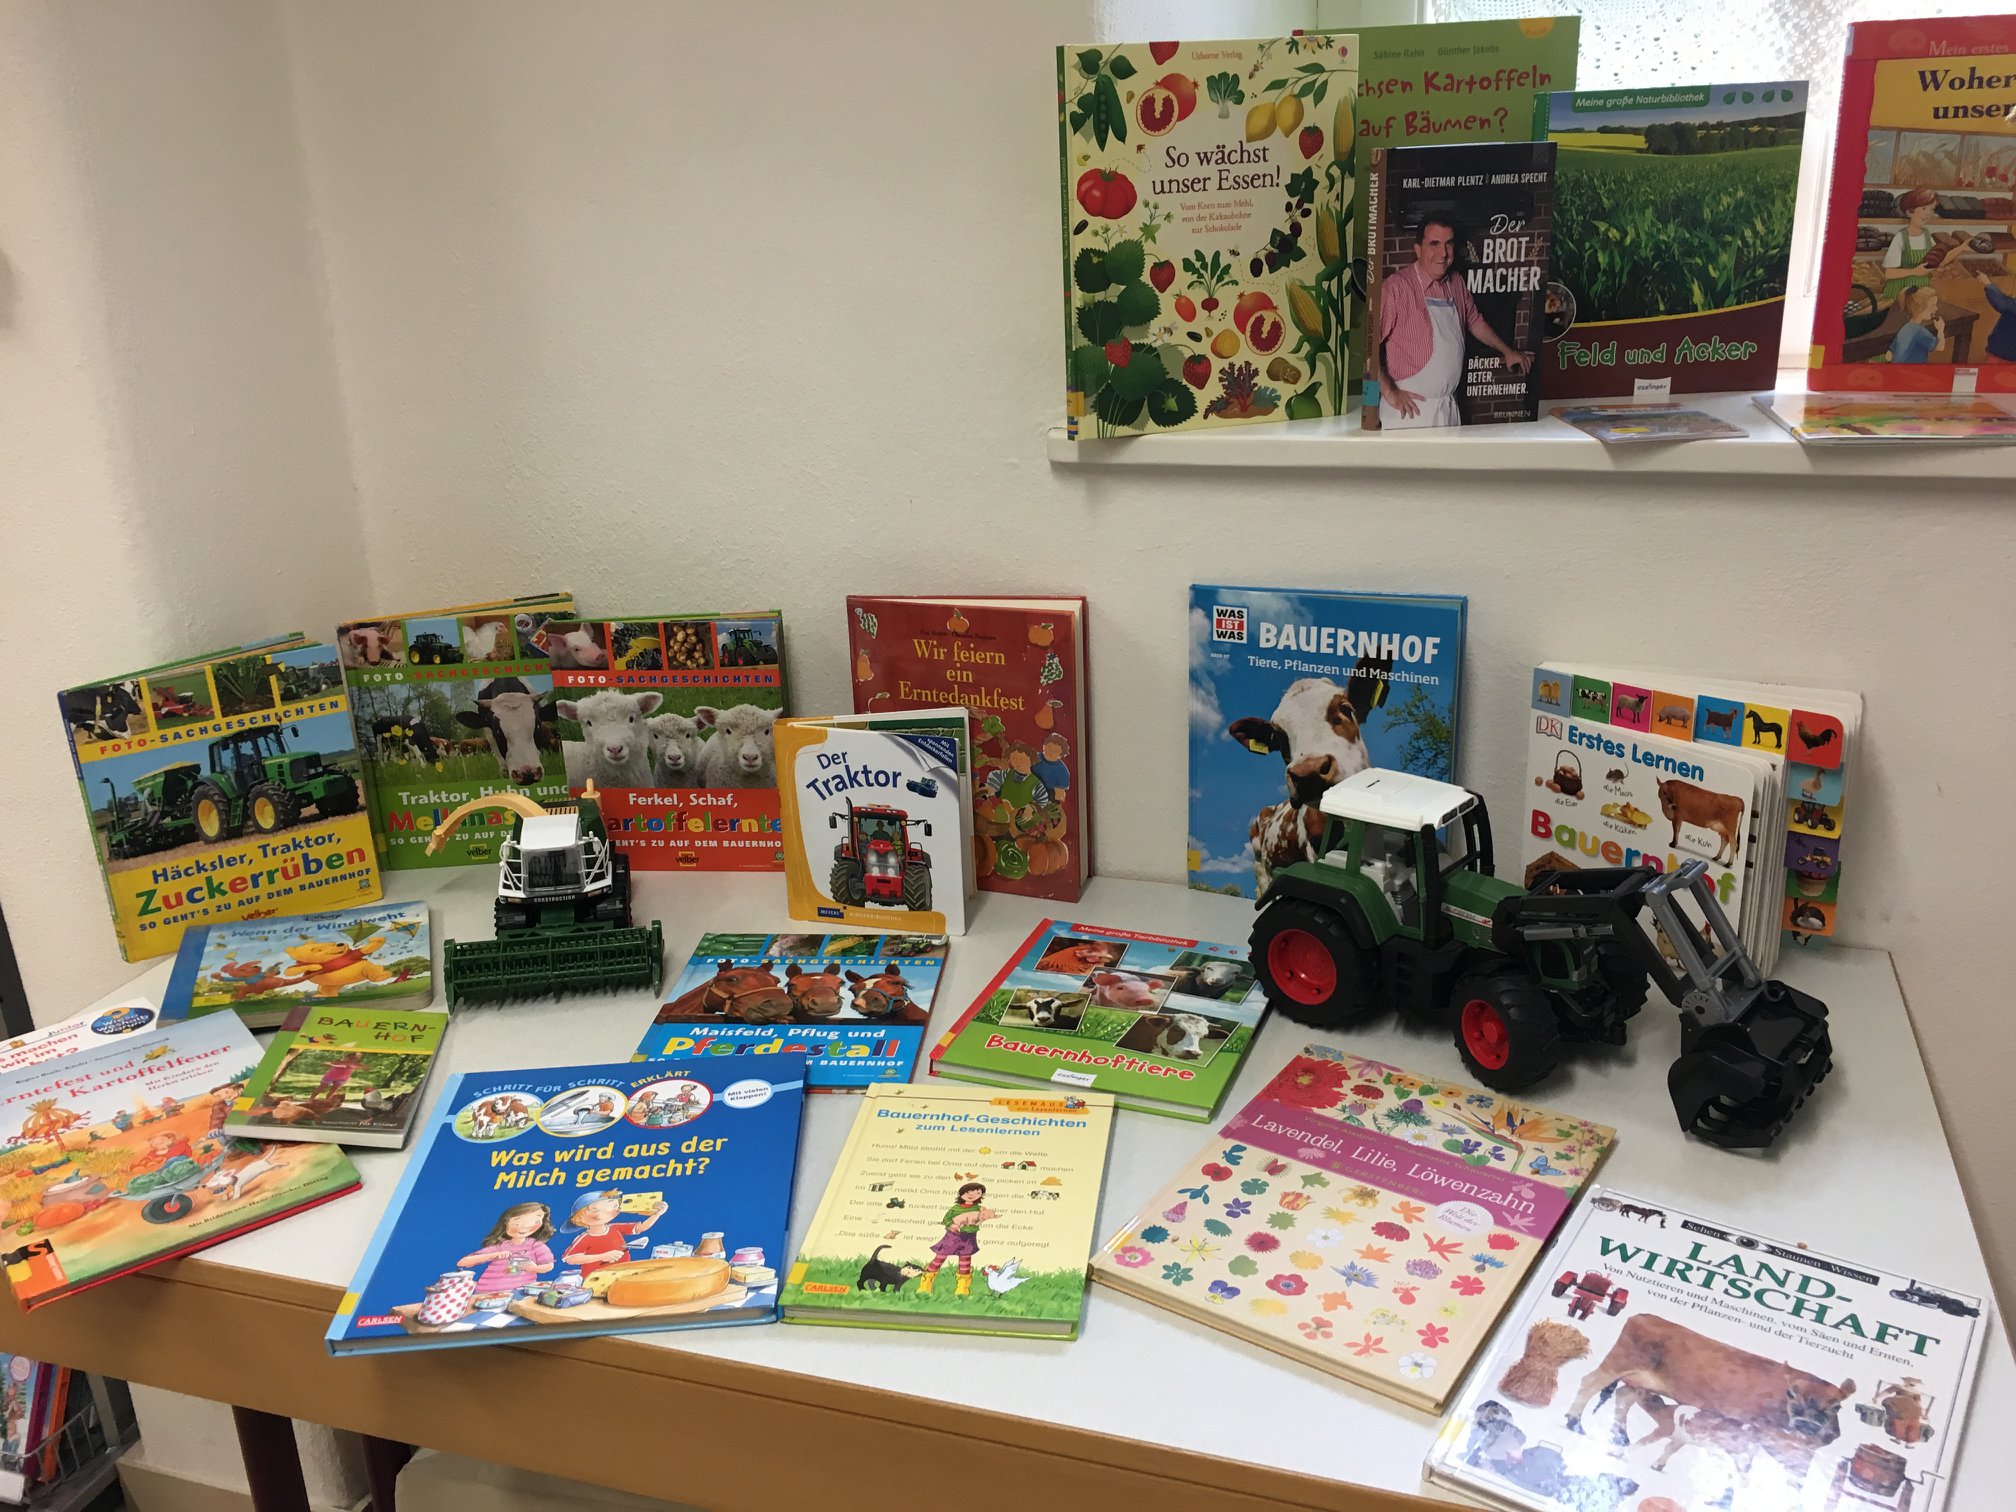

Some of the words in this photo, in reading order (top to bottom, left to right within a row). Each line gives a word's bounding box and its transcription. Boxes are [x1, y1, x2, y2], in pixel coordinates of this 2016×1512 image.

[1191, 51, 1221, 61] Usborne
[1221, 50, 1243, 61] Verlag
[1374, 50, 1402, 60] Sabine
[1403, 48, 1425, 59] Rahn
[1437, 45, 1471, 57] Günther
[1929, 40, 1966, 56] Mein
[1971, 43, 2009, 55] erstes
[1358, 77, 1414, 99] chsen
[1423, 65, 1552, 96] Kartoffeln
[1918, 66, 2016, 92] Woher
[1575, 97, 1604, 108] Meine
[1606, 96, 1634, 108] große
[1635, 92, 1705, 106] Naturbibliothek
[1359, 116, 1396, 138] auf
[1404, 107, 1509, 137] Bäumen?
[1165, 146, 1190, 168] So
[1199, 141, 1270, 167] wächst
[1152, 174, 1211, 195] unser
[1216, 165, 1281, 192] Essen!
[1402, 176, 1456, 189] KARL-DIETMAR
[1457, 174, 1484, 187] PLENTZ
[1491, 173, 1519, 184] ANDREA
[1521, 172, 1548, 183] SPECHT
[1180, 202, 1195, 211] Vom
[1197, 202, 1215, 211] Korn
[1181, 215, 1195, 223] von
[1196, 213, 1208, 223] der
[1209, 211, 1252, 222] Kakaobohne
[1367, 172, 1380, 256] BROTMACHER
[1204, 223, 1243, 233] Schokolade
[1489, 214, 1527, 236] Der
[1482, 236, 1530, 264] BROT
[1366, 260, 1376, 284] Der
[1466, 266, 1541, 294] MACHER
[1558, 341, 1617, 370] Feld
[1625, 343, 1666, 365] und
[1674, 335, 1758, 365] Acker
[1468, 357, 1502, 370] BÄCKER.
[1467, 371, 1495, 383] BETER.
[1466, 383, 1529, 397] UNTERNEHMER.
[1215, 608, 1245, 620] WAS
[1221, 619, 1240, 630] IST
[1215, 629, 1244, 641] WAS
[1259, 622, 1441, 665] BAUERNHOF
[912, 638, 948, 661] Wir
[953, 641, 1007, 667] feiern
[567, 675, 775, 685] FOTO-SACHGESCHICHTEN
[946, 664, 974, 684] ein
[1248, 656, 1282, 671] Tiere,
[1284, 660, 1340, 677] Pflanzen
[1342, 665, 1367, 679] und
[1369, 668, 1440, 686] Maschinen
[898, 680, 1026, 712] Erntedankfest
[100, 700, 340, 756] FOTO-SACHGESCHICHTEN
[1537, 717, 1560, 738] DK
[816, 750, 850, 771] Der
[1567, 724, 1627, 760] Erstes
[1631, 743, 1706, 783] Lernen
[805, 766, 903, 804] Traktor
[397, 790, 475, 806] Traktor,
[628, 792, 684, 808] Ferkel,
[689, 793, 738, 808] Schaf,
[608, 811, 782, 833] artoffelernte
[389, 837, 405, 846] SO
[455, 832, 469, 841] ZU
[474, 831, 496, 840] AUF
[651, 840, 665, 848] ZU
[669, 840, 691, 848] AUF
[694, 840, 718, 848] DEM
[151, 852, 255, 885] Häcksler,
[257, 830, 342, 860] Traktor,
[466, 847, 492, 857] velber
[675, 854, 700, 865] velber
[135, 846, 367, 918] Zuckerrüben
[139, 920, 157, 932] SO
[215, 902, 232, 913] ZU
[237, 894, 262, 908] AUF
[267, 886, 294, 901] DEM
[299, 868, 372, 893] BAUERNHOF
[533, 895, 576, 903] CONSTRUCTION
[819, 909, 841, 917] MEYERS
[231, 926, 277, 938] Wenn
[282, 923, 315, 935] der
[317, 918, 361, 931] Wind
[364, 911, 406, 924] weht
[1078, 925, 1103, 935] Meine
[1104, 929, 1132, 940] große
[1133, 932, 1190, 948] Tierbibliothek
[706, 957, 936, 966] FOTO-SACHGESCHICHTEN
[317, 1017, 437, 1033] BAUERN-
[689, 1027, 779, 1039] Maisfeld,
[787, 1027, 841, 1041] Pflug
[848, 1029, 887, 1039] und
[10, 1033, 79, 1059] machen
[374, 1031, 426, 1044] HOF
[662, 1037, 901, 1059] Pferdestall
[1, 1057, 29, 1069] wir
[34, 1047, 58, 1060] im
[984, 1033, 1195, 1082] Bauernhoftiere
[68, 1045, 232, 1099] Kartoffelfeuer
[0, 1073, 94, 1106] rntefest
[100, 1060, 135, 1078] und
[473, 1083, 533, 1098] SCHRITT
[535, 1082, 563, 1095] FÜR
[567, 1076, 626, 1091] SCHRITT
[630, 1069, 691, 1089] ERKLÄRT
[728, 1091, 745, 1099] Mit
[746, 1087, 770, 1097] vielen
[729, 1091, 768, 1103] Klappen!
[998, 1099, 1064, 1108] LESEMAUS
[876, 1108, 1087, 1129] Bauernhof-Geschichten
[915, 1122, 946, 1132] zum
[950, 1124, 1041, 1138] Lesenlernen
[491, 1147, 551, 1168] Was
[553, 1142, 614, 1164] wird
[624, 1141, 671, 1158] aus
[681, 1136, 728, 1154] der
[493, 1167, 566, 1190] Milch
[576, 1157, 711, 1187] gemacht?
[1250, 1113, 1343, 1155] Lavendel,
[1350, 1145, 1399, 1172] Lilie,
[1406, 1163, 1537, 1215] Löwenzahn
[1344, 1165, 1428, 1197] GERSTENBERG
[1445, 1208, 1465, 1223] Welt
[1463, 1216, 1480, 1227] der
[1459, 1206, 1478, 1218] Die
[1437, 1213, 1473, 1233] Blumen
[1686, 1222, 1722, 1239] Sehen
[1774, 1247, 1822, 1269] Staunen
[1829, 1263, 1875, 1285] Wissen
[1685, 1240, 1854, 1304] LAND-
[804, 1284, 849, 1294] CARLSEN
[1599, 1235, 1942, 1357] WIRTSCHAFT
[357, 1316, 403, 1327] CARLSEN
[1603, 1262, 1625, 1277] Von
[1626, 1268, 1685, 1297] Nutztieren
[1685, 1288, 1709, 1304] und
[1710, 1294, 1779, 1325] Maschinen,
[1781, 1318, 1809, 1334] vom
[1810, 1325, 1842, 1347] Säen
[1842, 1335, 1867, 1354] und
[1868, 1345, 1916, 1369] Ernten,
[1647, 1288, 1668, 1301] von
[1668, 1292, 1691, 1307] der
[1691, 1297, 1747, 1326] Pflanzen-
[1748, 1318, 1773, 1336] und
[1773, 1325, 1795, 1343] der
[1794, 1333, 1856, 1362] Tierzucht
